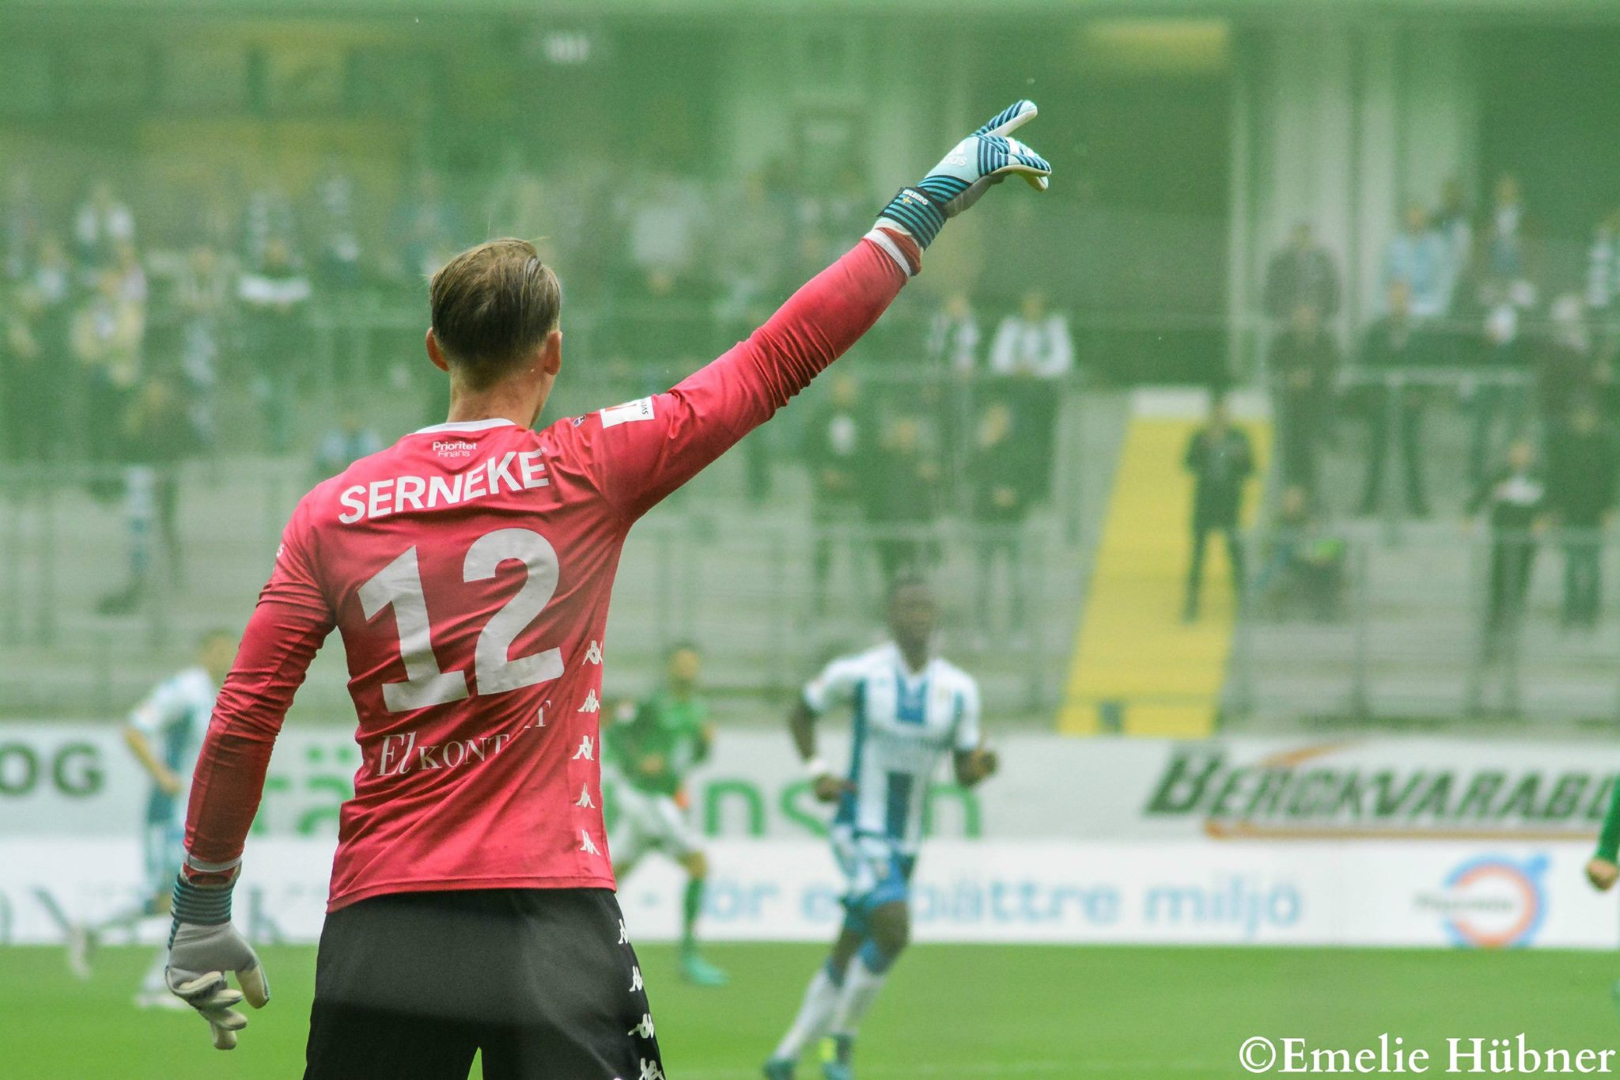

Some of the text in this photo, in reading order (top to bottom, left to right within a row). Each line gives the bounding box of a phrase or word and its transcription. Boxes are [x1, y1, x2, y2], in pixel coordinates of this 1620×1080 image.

[432, 440, 478, 451] Prioritet
[437, 450, 471, 458] Finans
[338, 449, 550, 525] SERNEKE
[357, 527, 565, 713] 12
[1143, 872, 1302, 938] miljö
